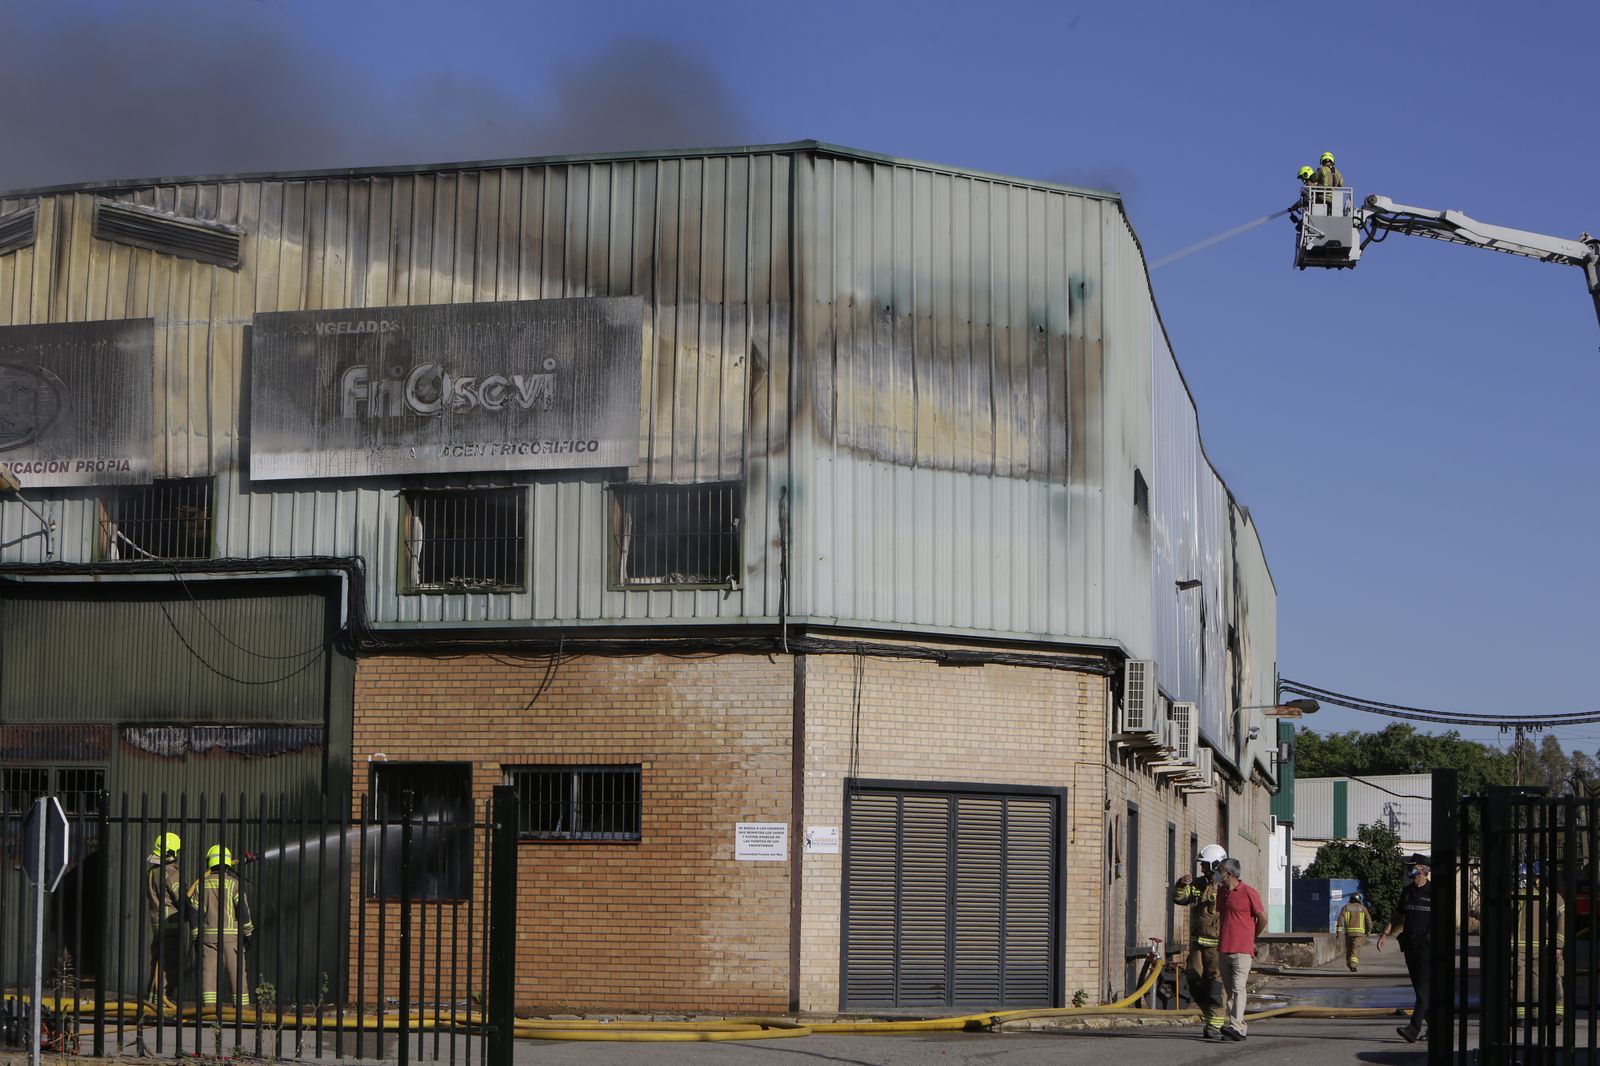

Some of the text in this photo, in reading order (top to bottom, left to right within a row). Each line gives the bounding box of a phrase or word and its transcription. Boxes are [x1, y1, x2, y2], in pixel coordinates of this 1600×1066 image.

[290, 319, 400, 337] NGELADOS
[491, 438, 599, 457] FRIGORIFICO
[75, 460, 131, 473] PROPIA
